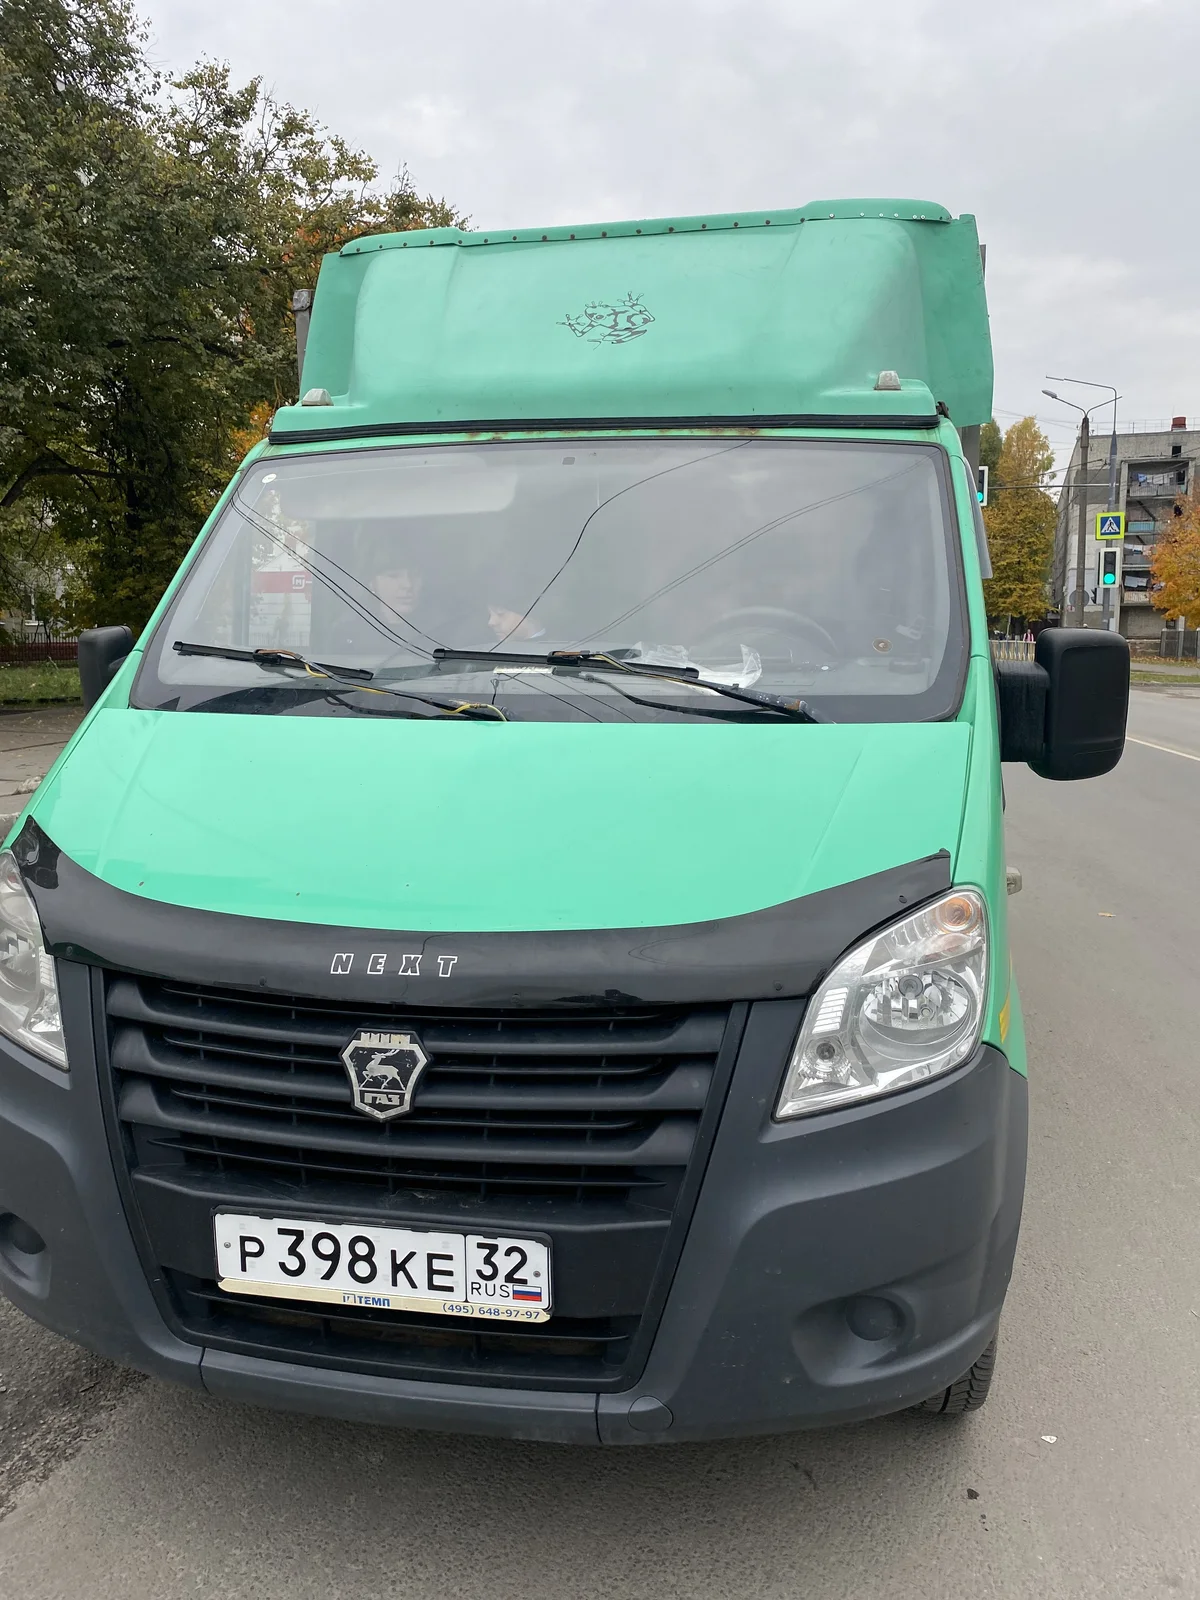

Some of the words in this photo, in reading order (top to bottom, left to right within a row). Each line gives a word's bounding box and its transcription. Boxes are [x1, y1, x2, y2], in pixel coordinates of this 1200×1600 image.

[330, 953, 458, 977] NEXT
[364, 1092, 400, 1106] ГАЗ
[476, 1242, 528, 1285] 32
[471, 1282, 510, 1298] RUS
[442, 1302, 475, 1315] (495)
[478, 1306, 540, 1320] 648-97-97
